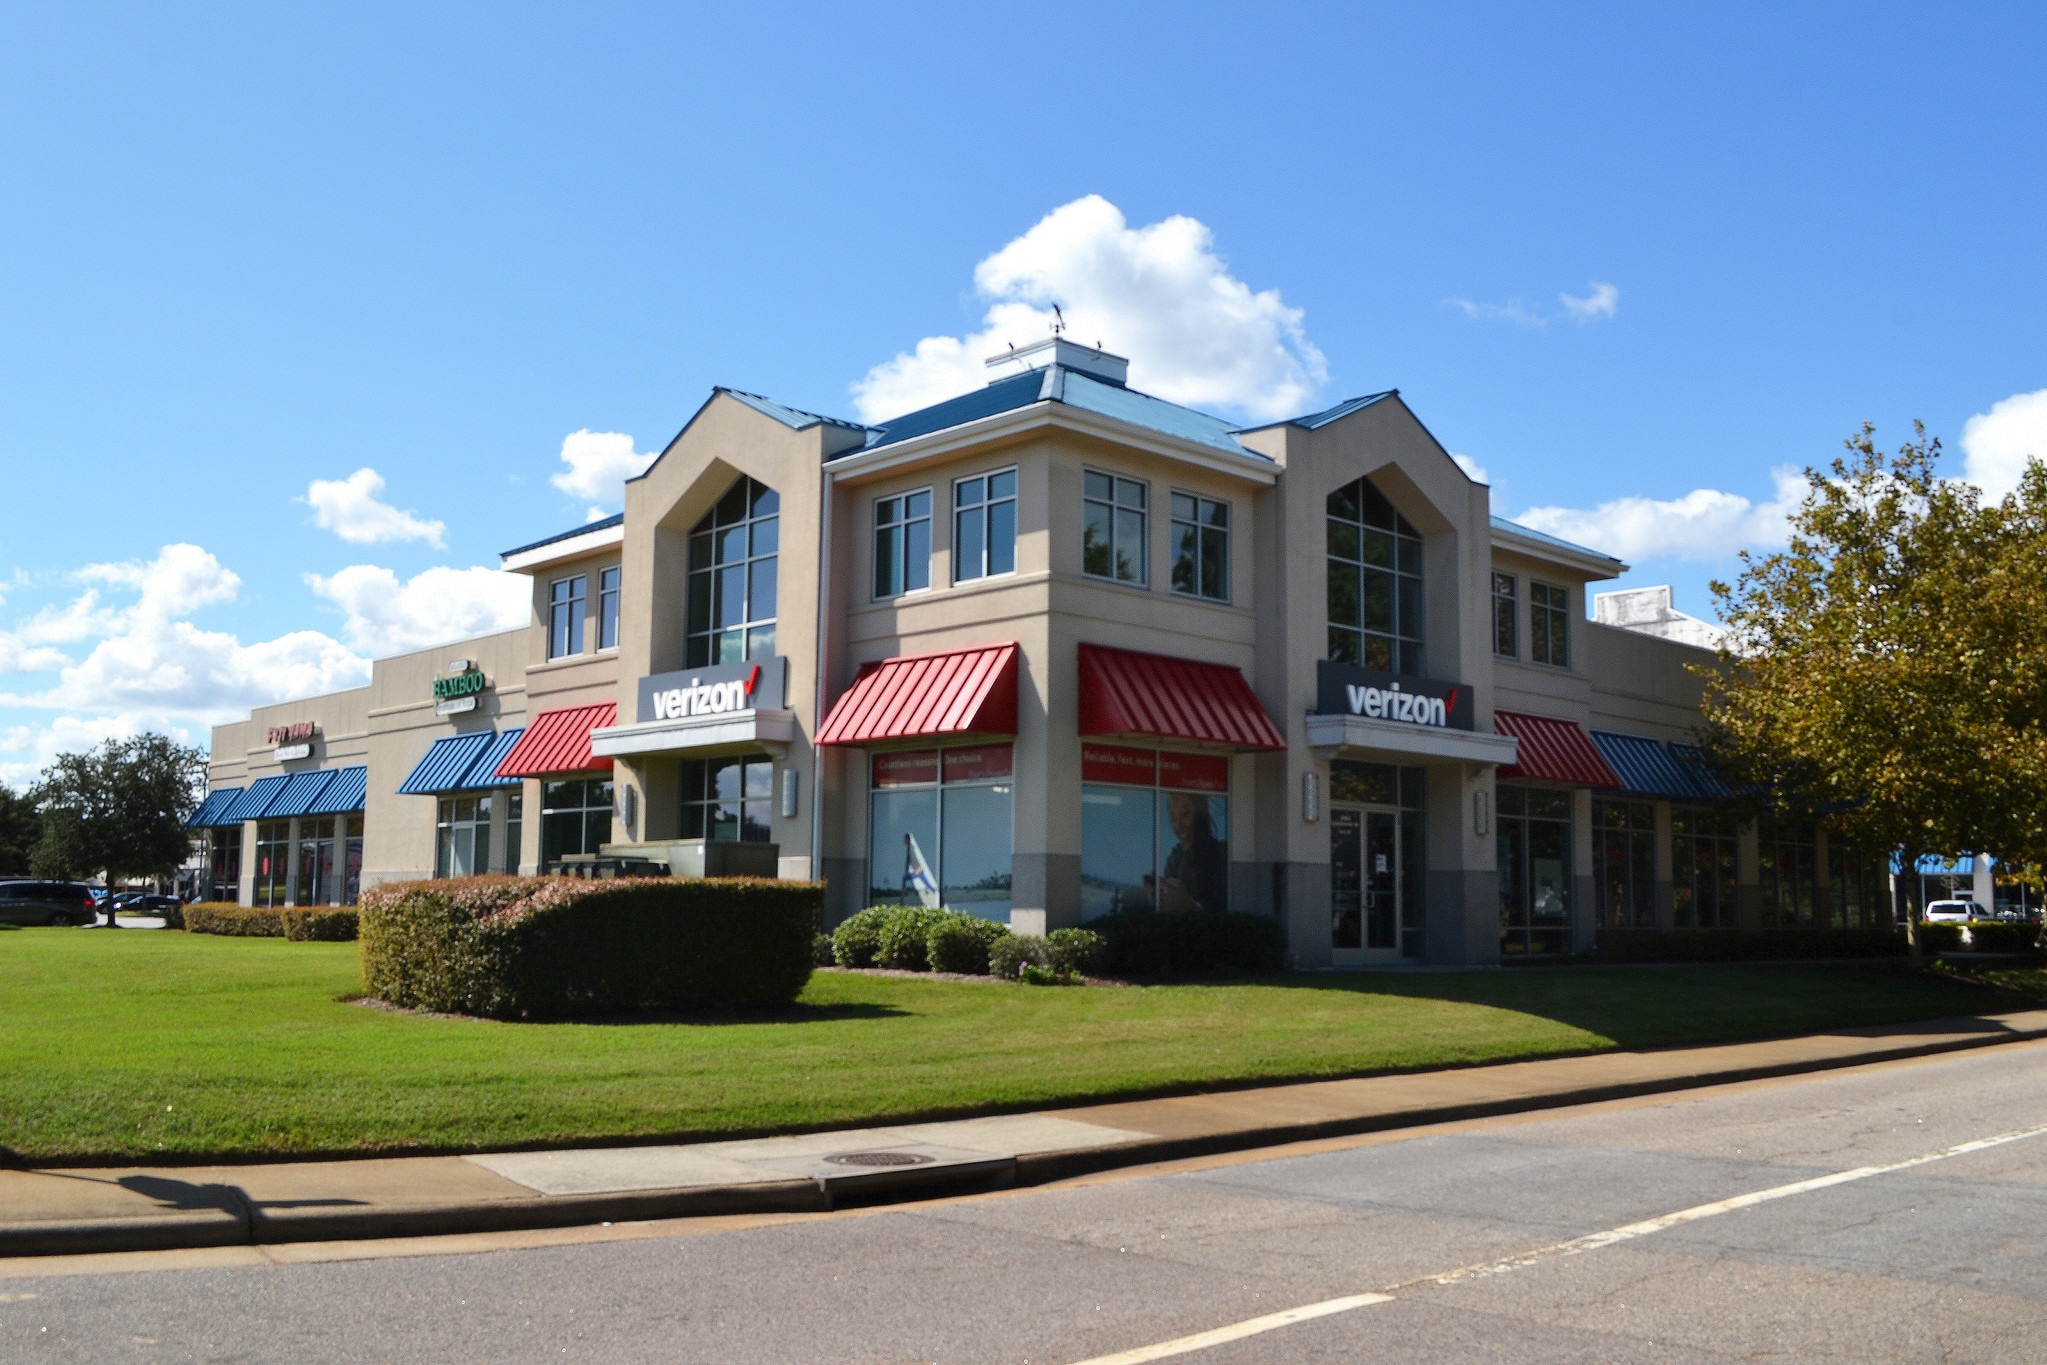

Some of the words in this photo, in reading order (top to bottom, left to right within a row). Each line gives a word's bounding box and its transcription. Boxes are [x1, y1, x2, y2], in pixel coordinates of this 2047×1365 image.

[433, 672, 483, 698] BAMBOO
[653, 677, 744, 720] verizon
[1346, 682, 1446, 726] verizon
